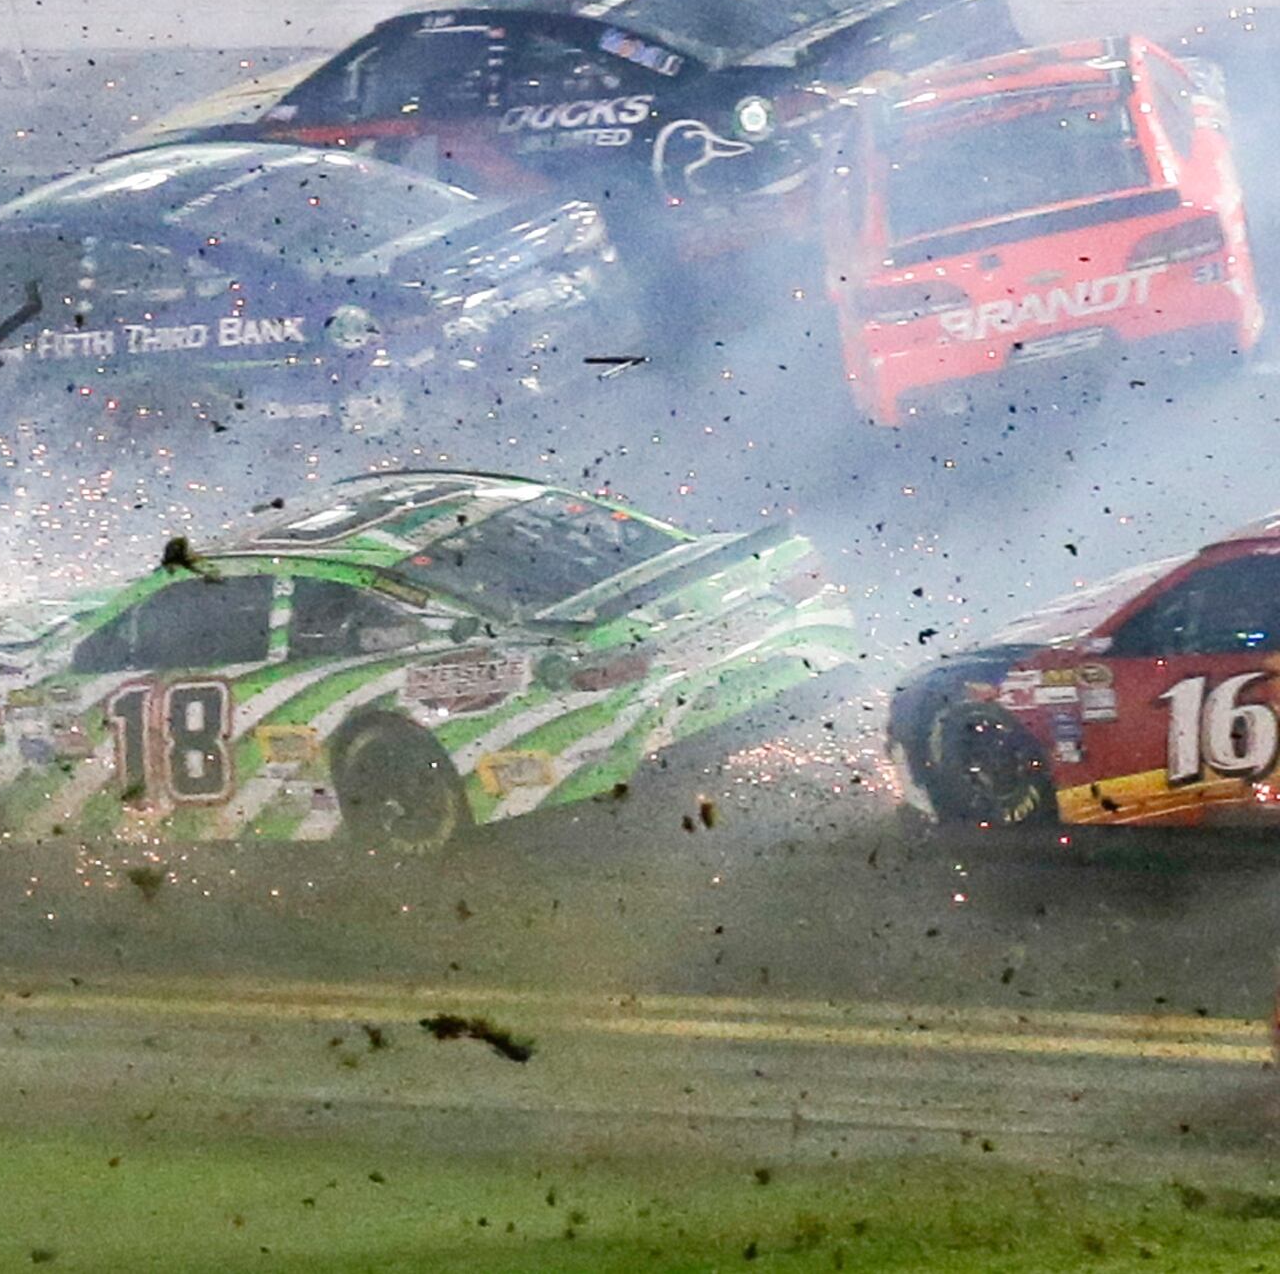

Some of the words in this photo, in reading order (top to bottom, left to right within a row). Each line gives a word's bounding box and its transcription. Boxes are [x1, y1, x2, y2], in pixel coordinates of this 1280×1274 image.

[217, 316, 304, 347] BANK
[939, 266, 1171, 343] BRANDT
[103, 677, 234, 806] 18
[1157, 671, 1280, 784] 16
